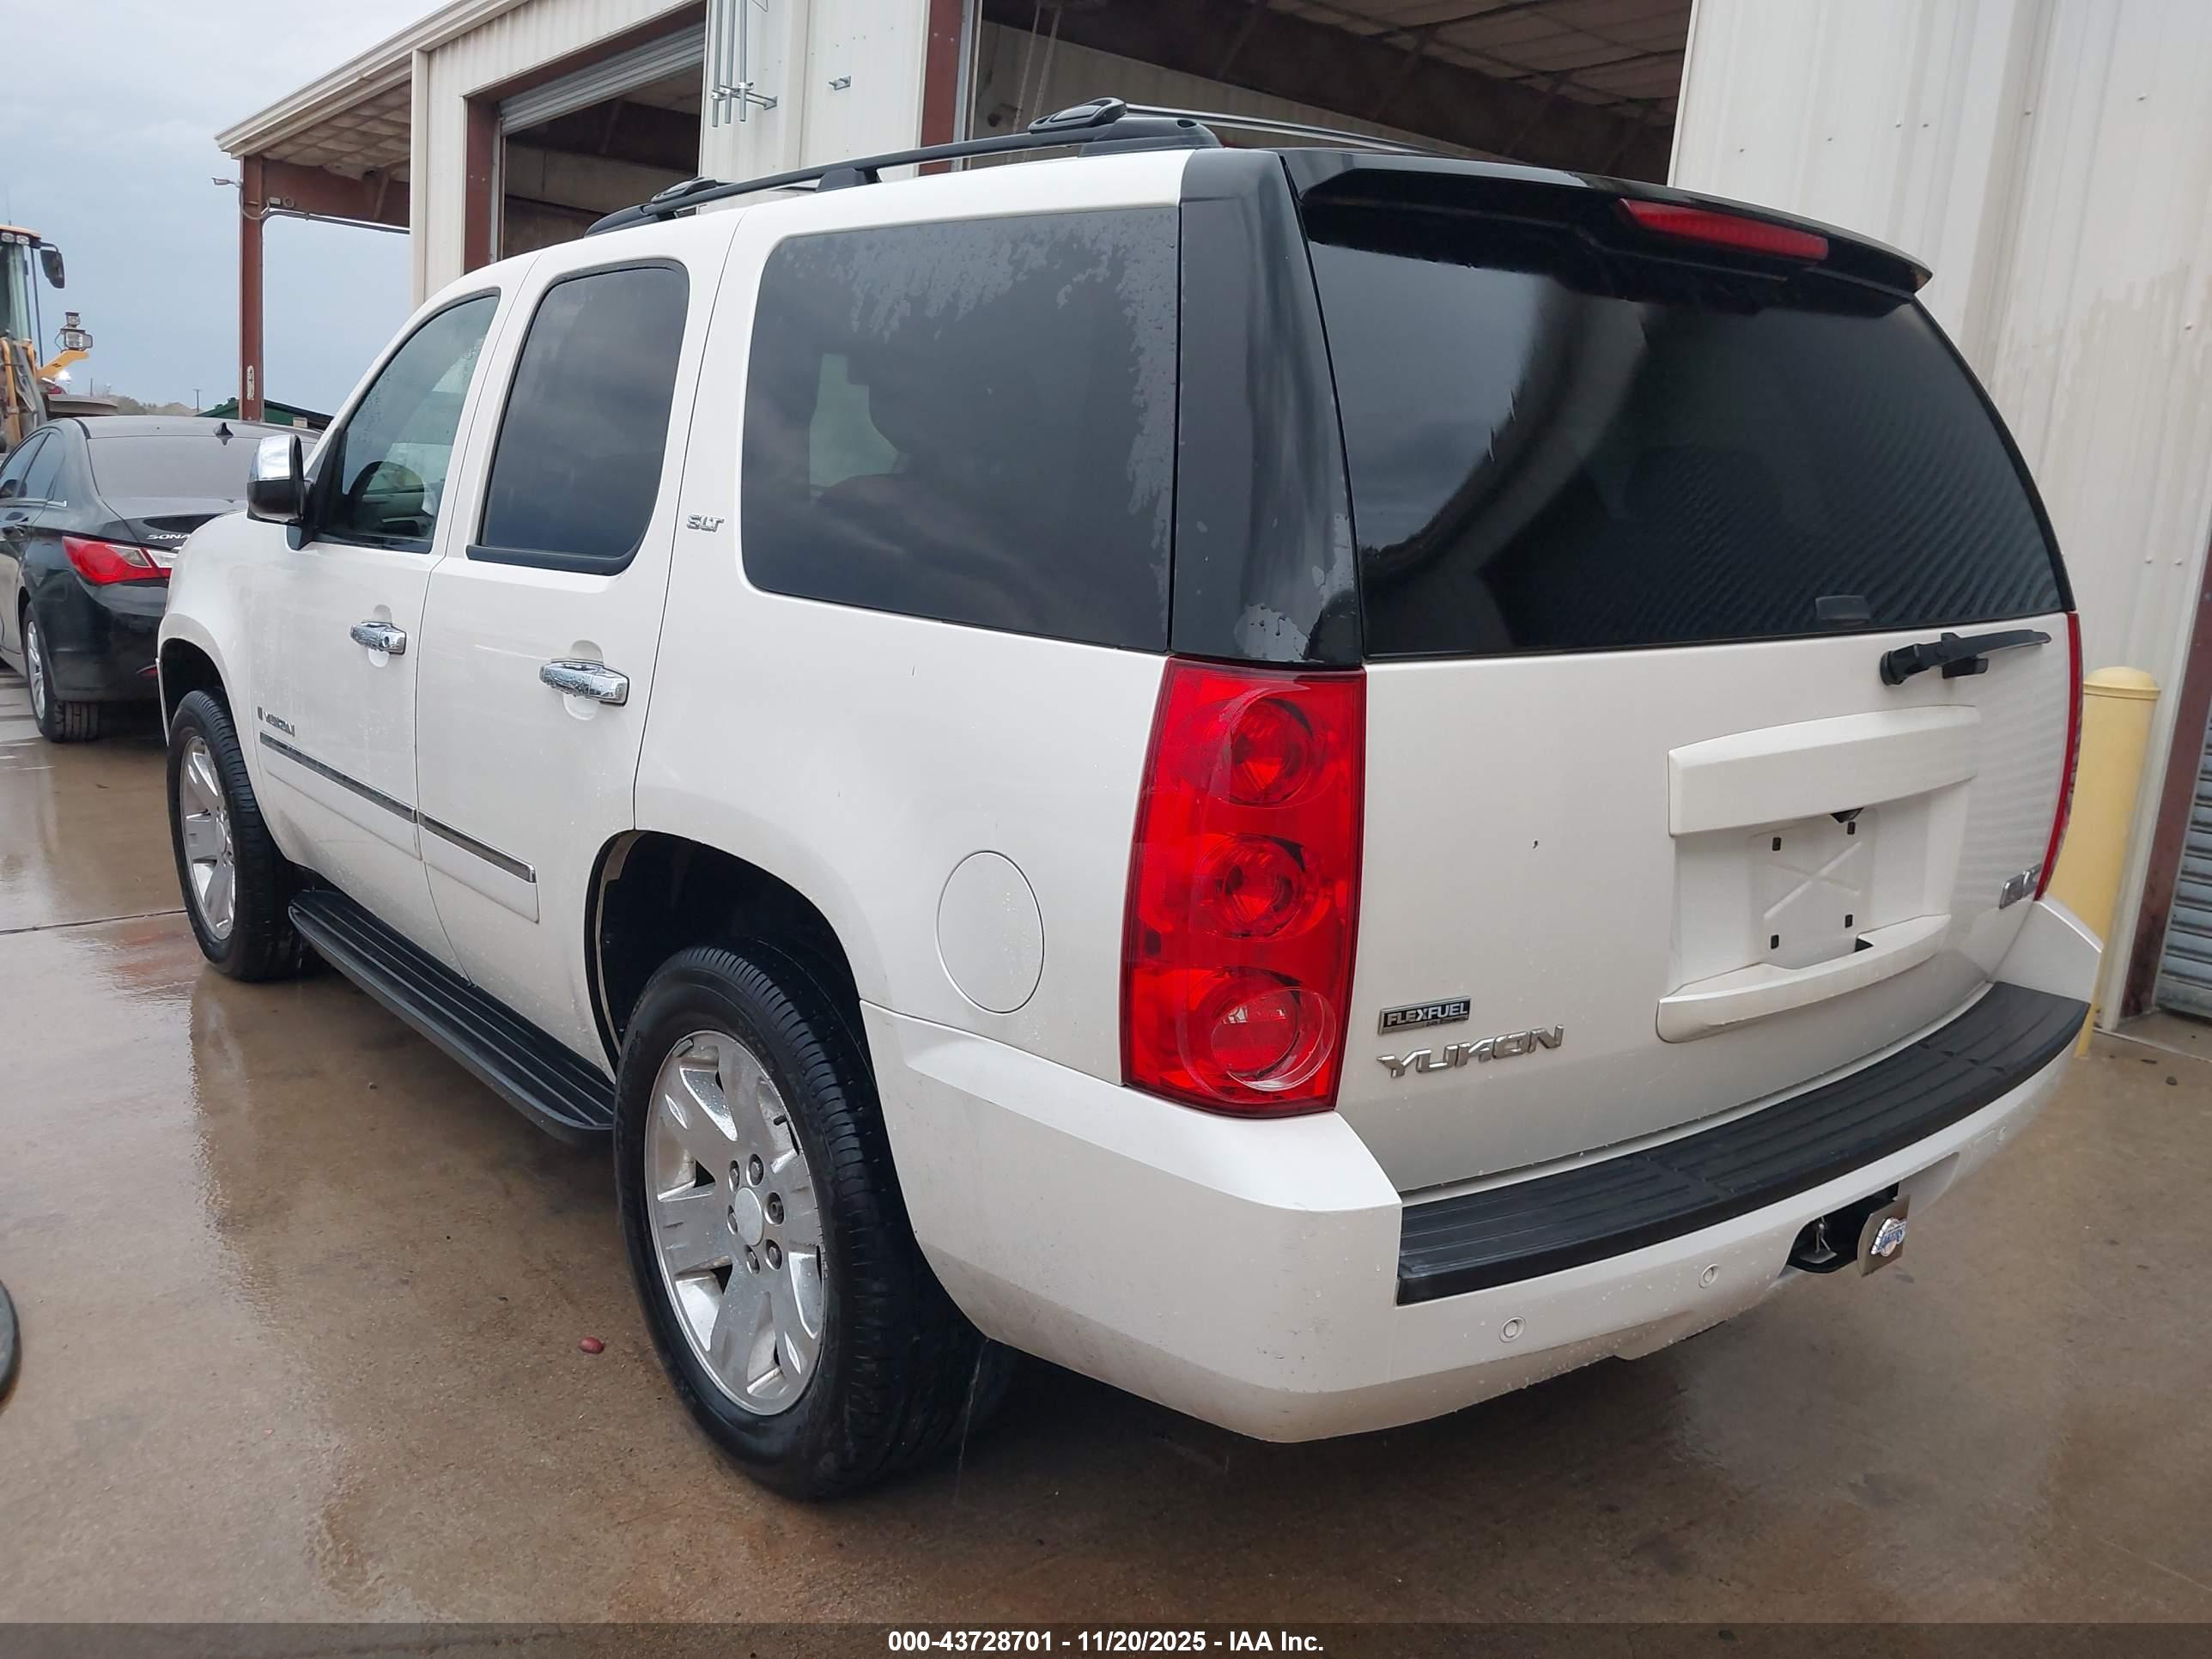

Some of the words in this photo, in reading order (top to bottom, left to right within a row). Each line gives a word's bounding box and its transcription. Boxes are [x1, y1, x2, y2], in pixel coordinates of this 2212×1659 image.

[686, 514, 725, 532] SLT
[1387, 1002, 1468, 1026] FLEXFUEL
[1376, 1024, 1565, 1079] YUKON
